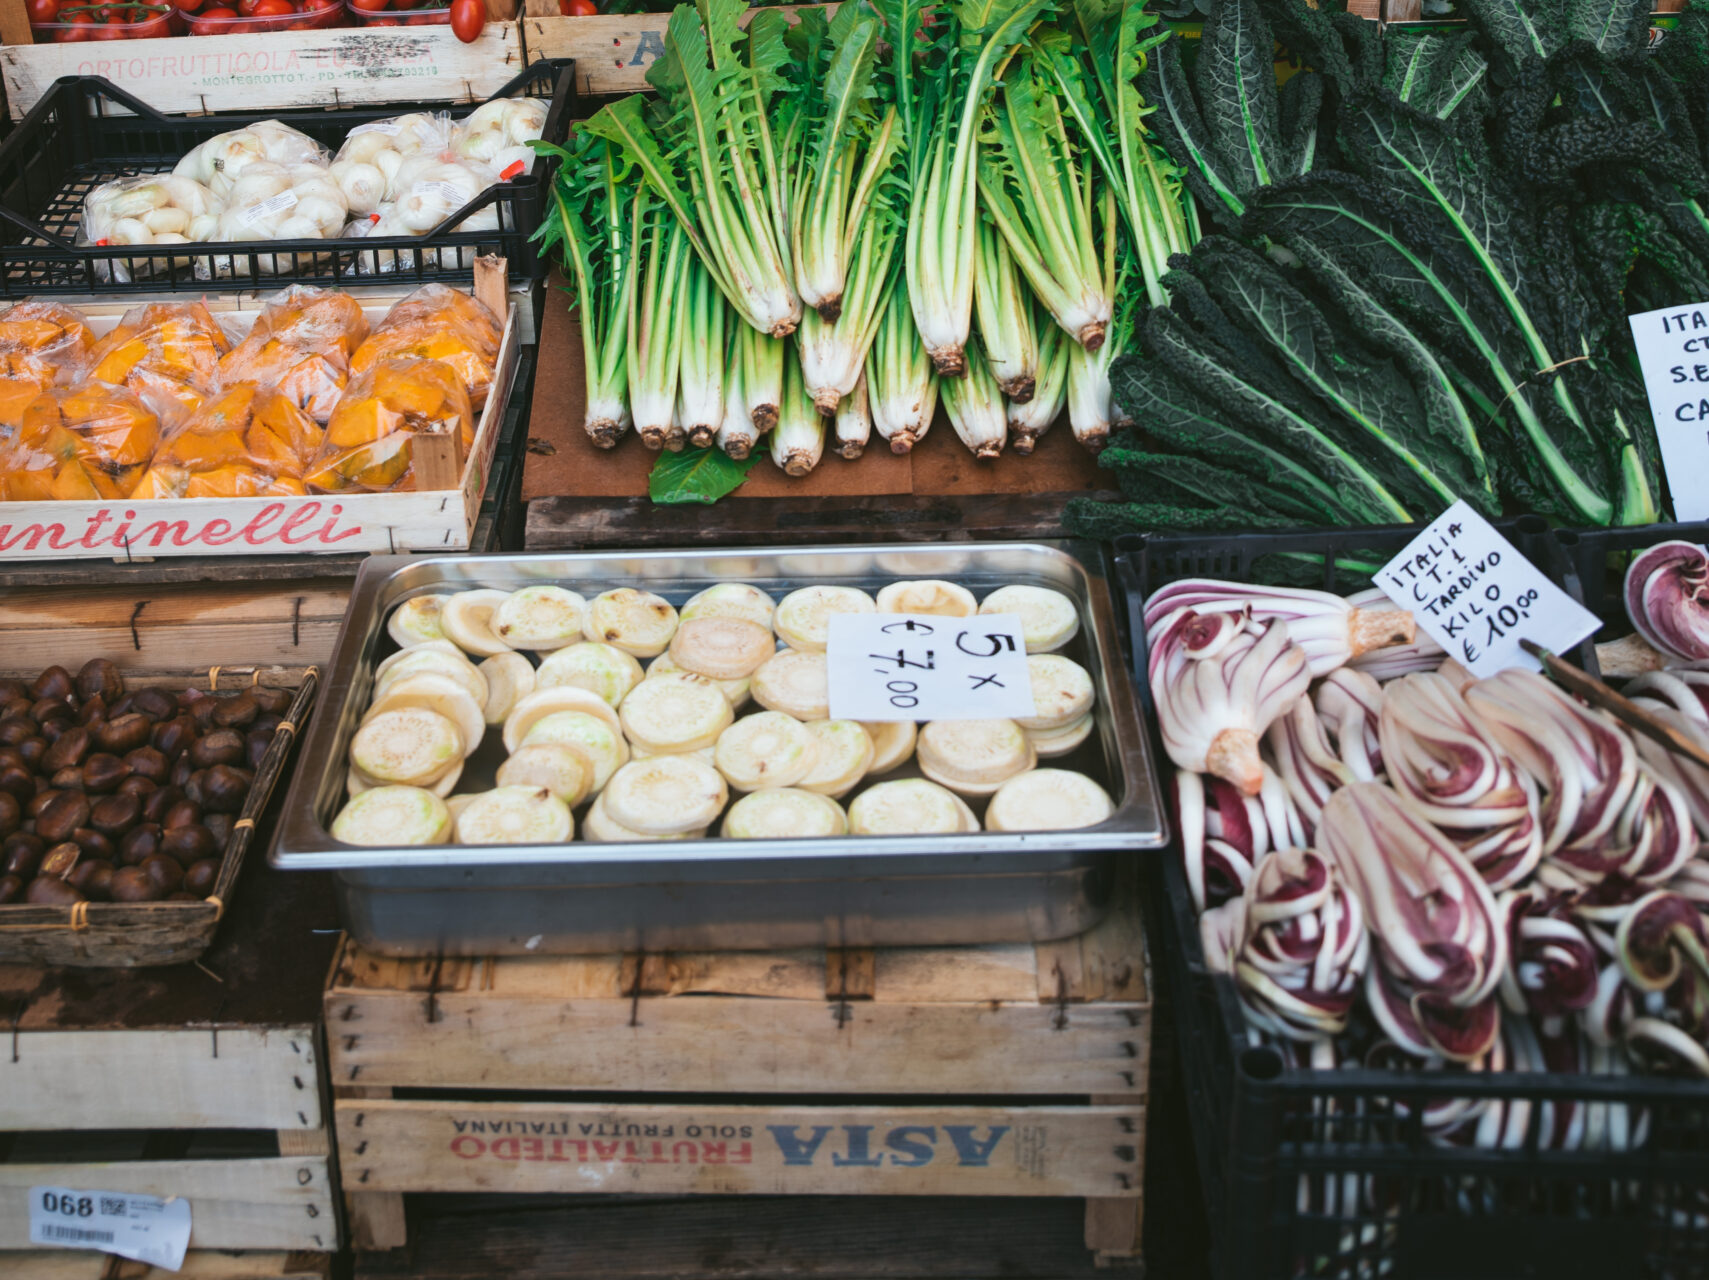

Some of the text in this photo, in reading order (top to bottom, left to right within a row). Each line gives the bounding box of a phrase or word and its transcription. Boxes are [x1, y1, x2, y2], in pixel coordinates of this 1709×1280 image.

[77, 49, 300, 80] ORTOFRUTTICOLA
[202, 74, 295, 87] MONTEGROTTO
[1441, 584, 1501, 639] KILO
[1463, 638, 1481, 663] €
[453, 1120, 753, 1138] SOLO FRUTTA ITALIANA
[450, 1135, 753, 1163] FRUTTALTEDO
[765, 1125, 1011, 1167] ASTA
[42, 1191, 94, 1218] 068
